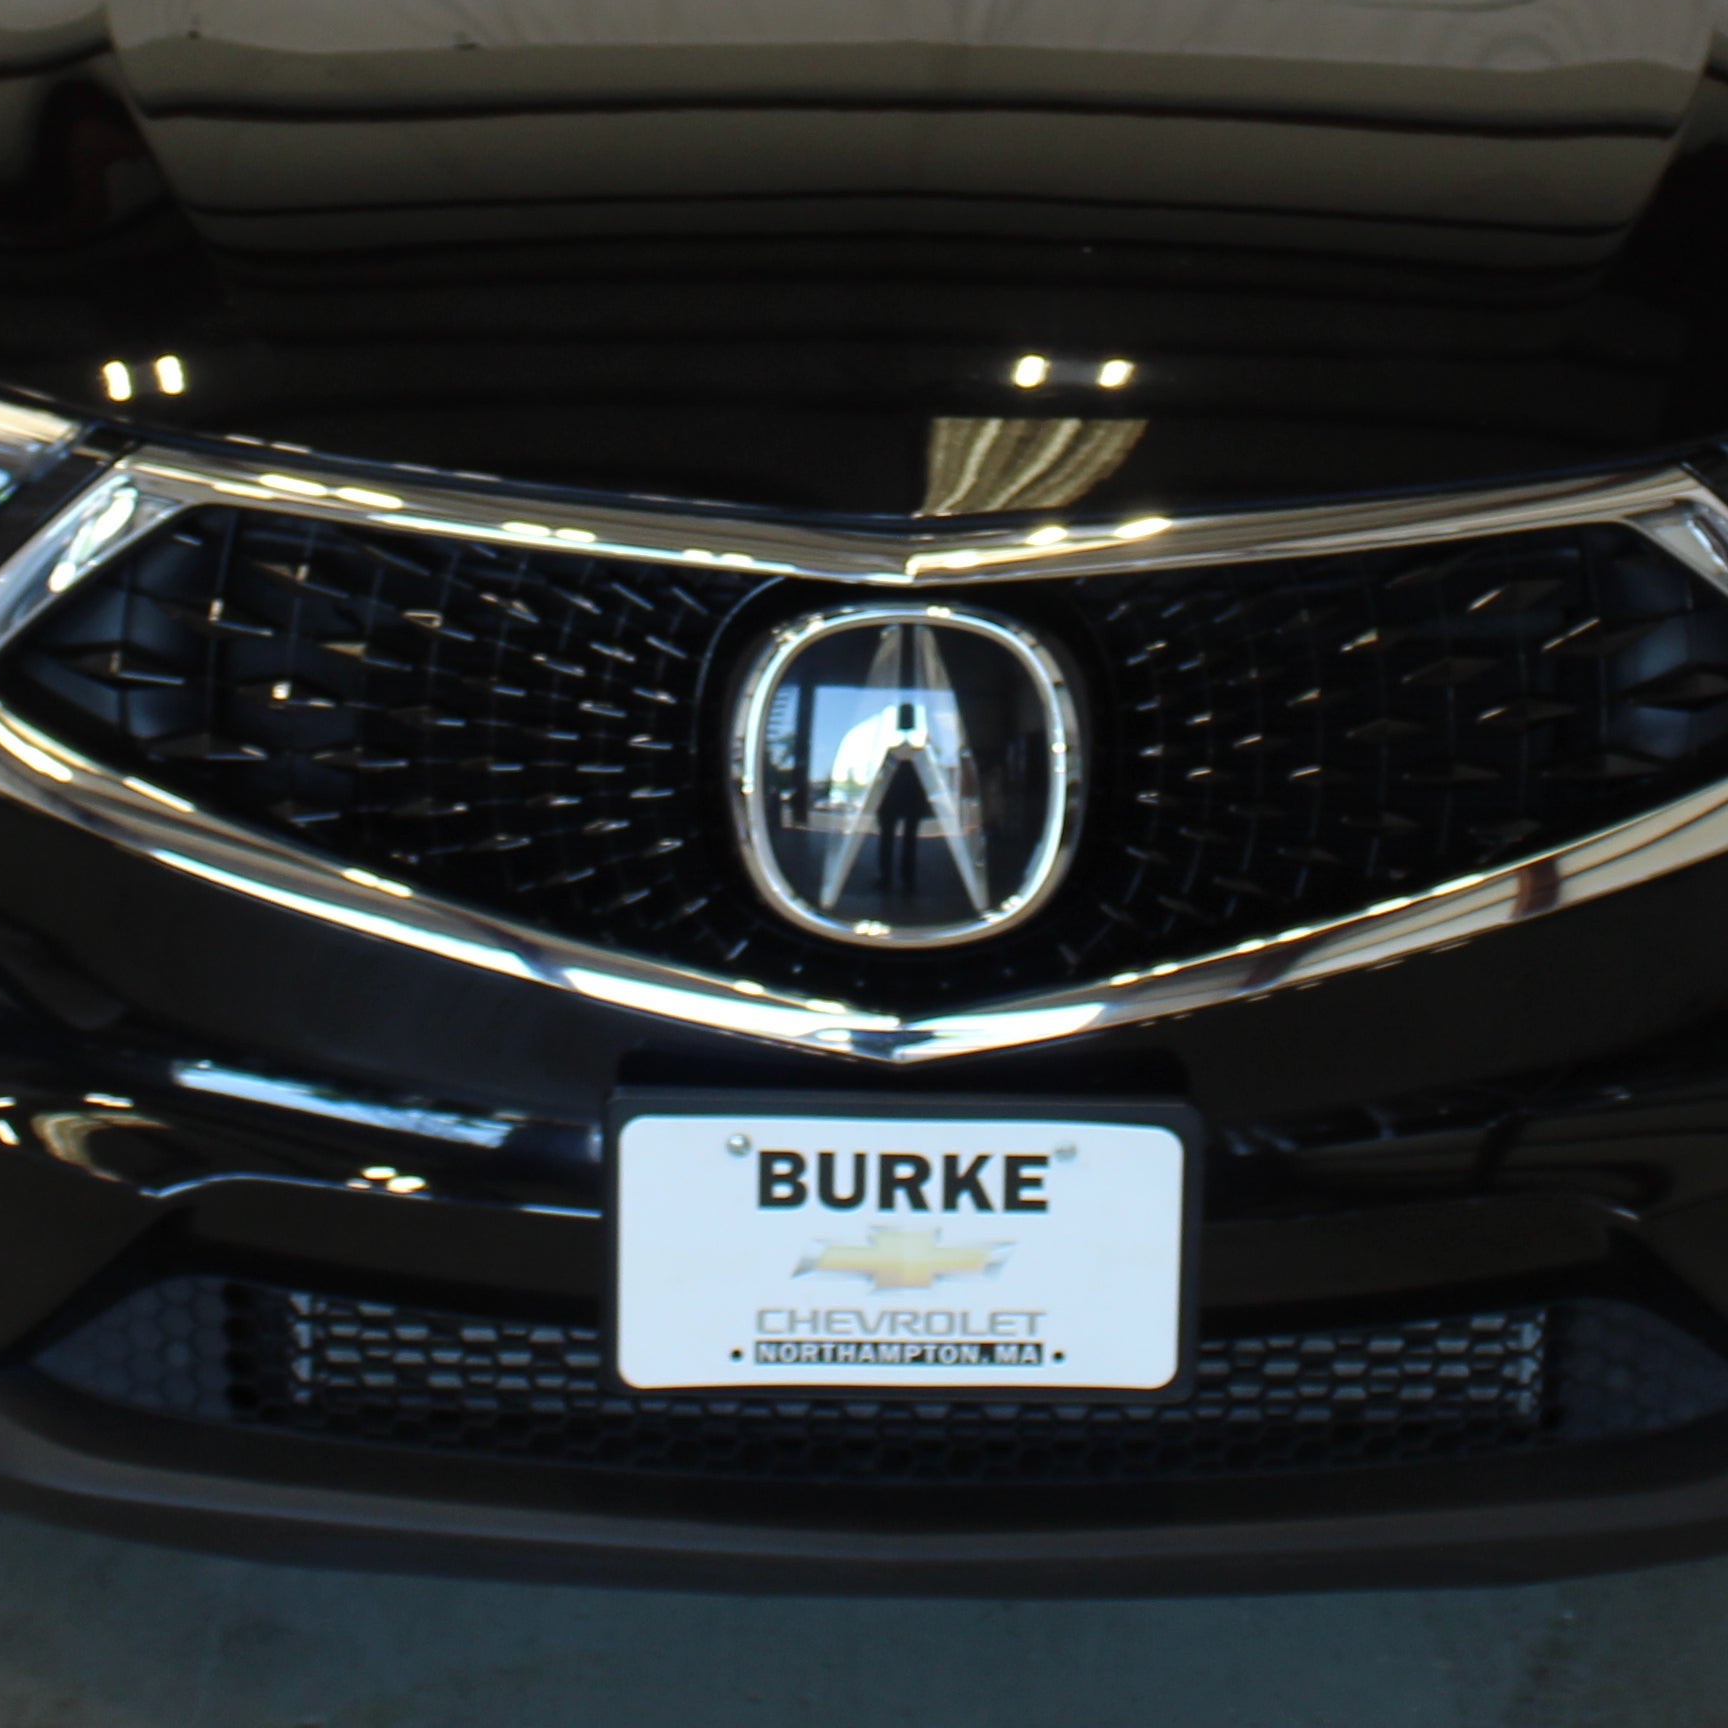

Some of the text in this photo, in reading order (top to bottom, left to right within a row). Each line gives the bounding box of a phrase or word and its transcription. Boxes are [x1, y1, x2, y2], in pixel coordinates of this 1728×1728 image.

[757, 1149, 1050, 1213] BURKE
[756, 1308, 1048, 1337] CHEVROLET
[994, 1344, 1041, 1364] MA
